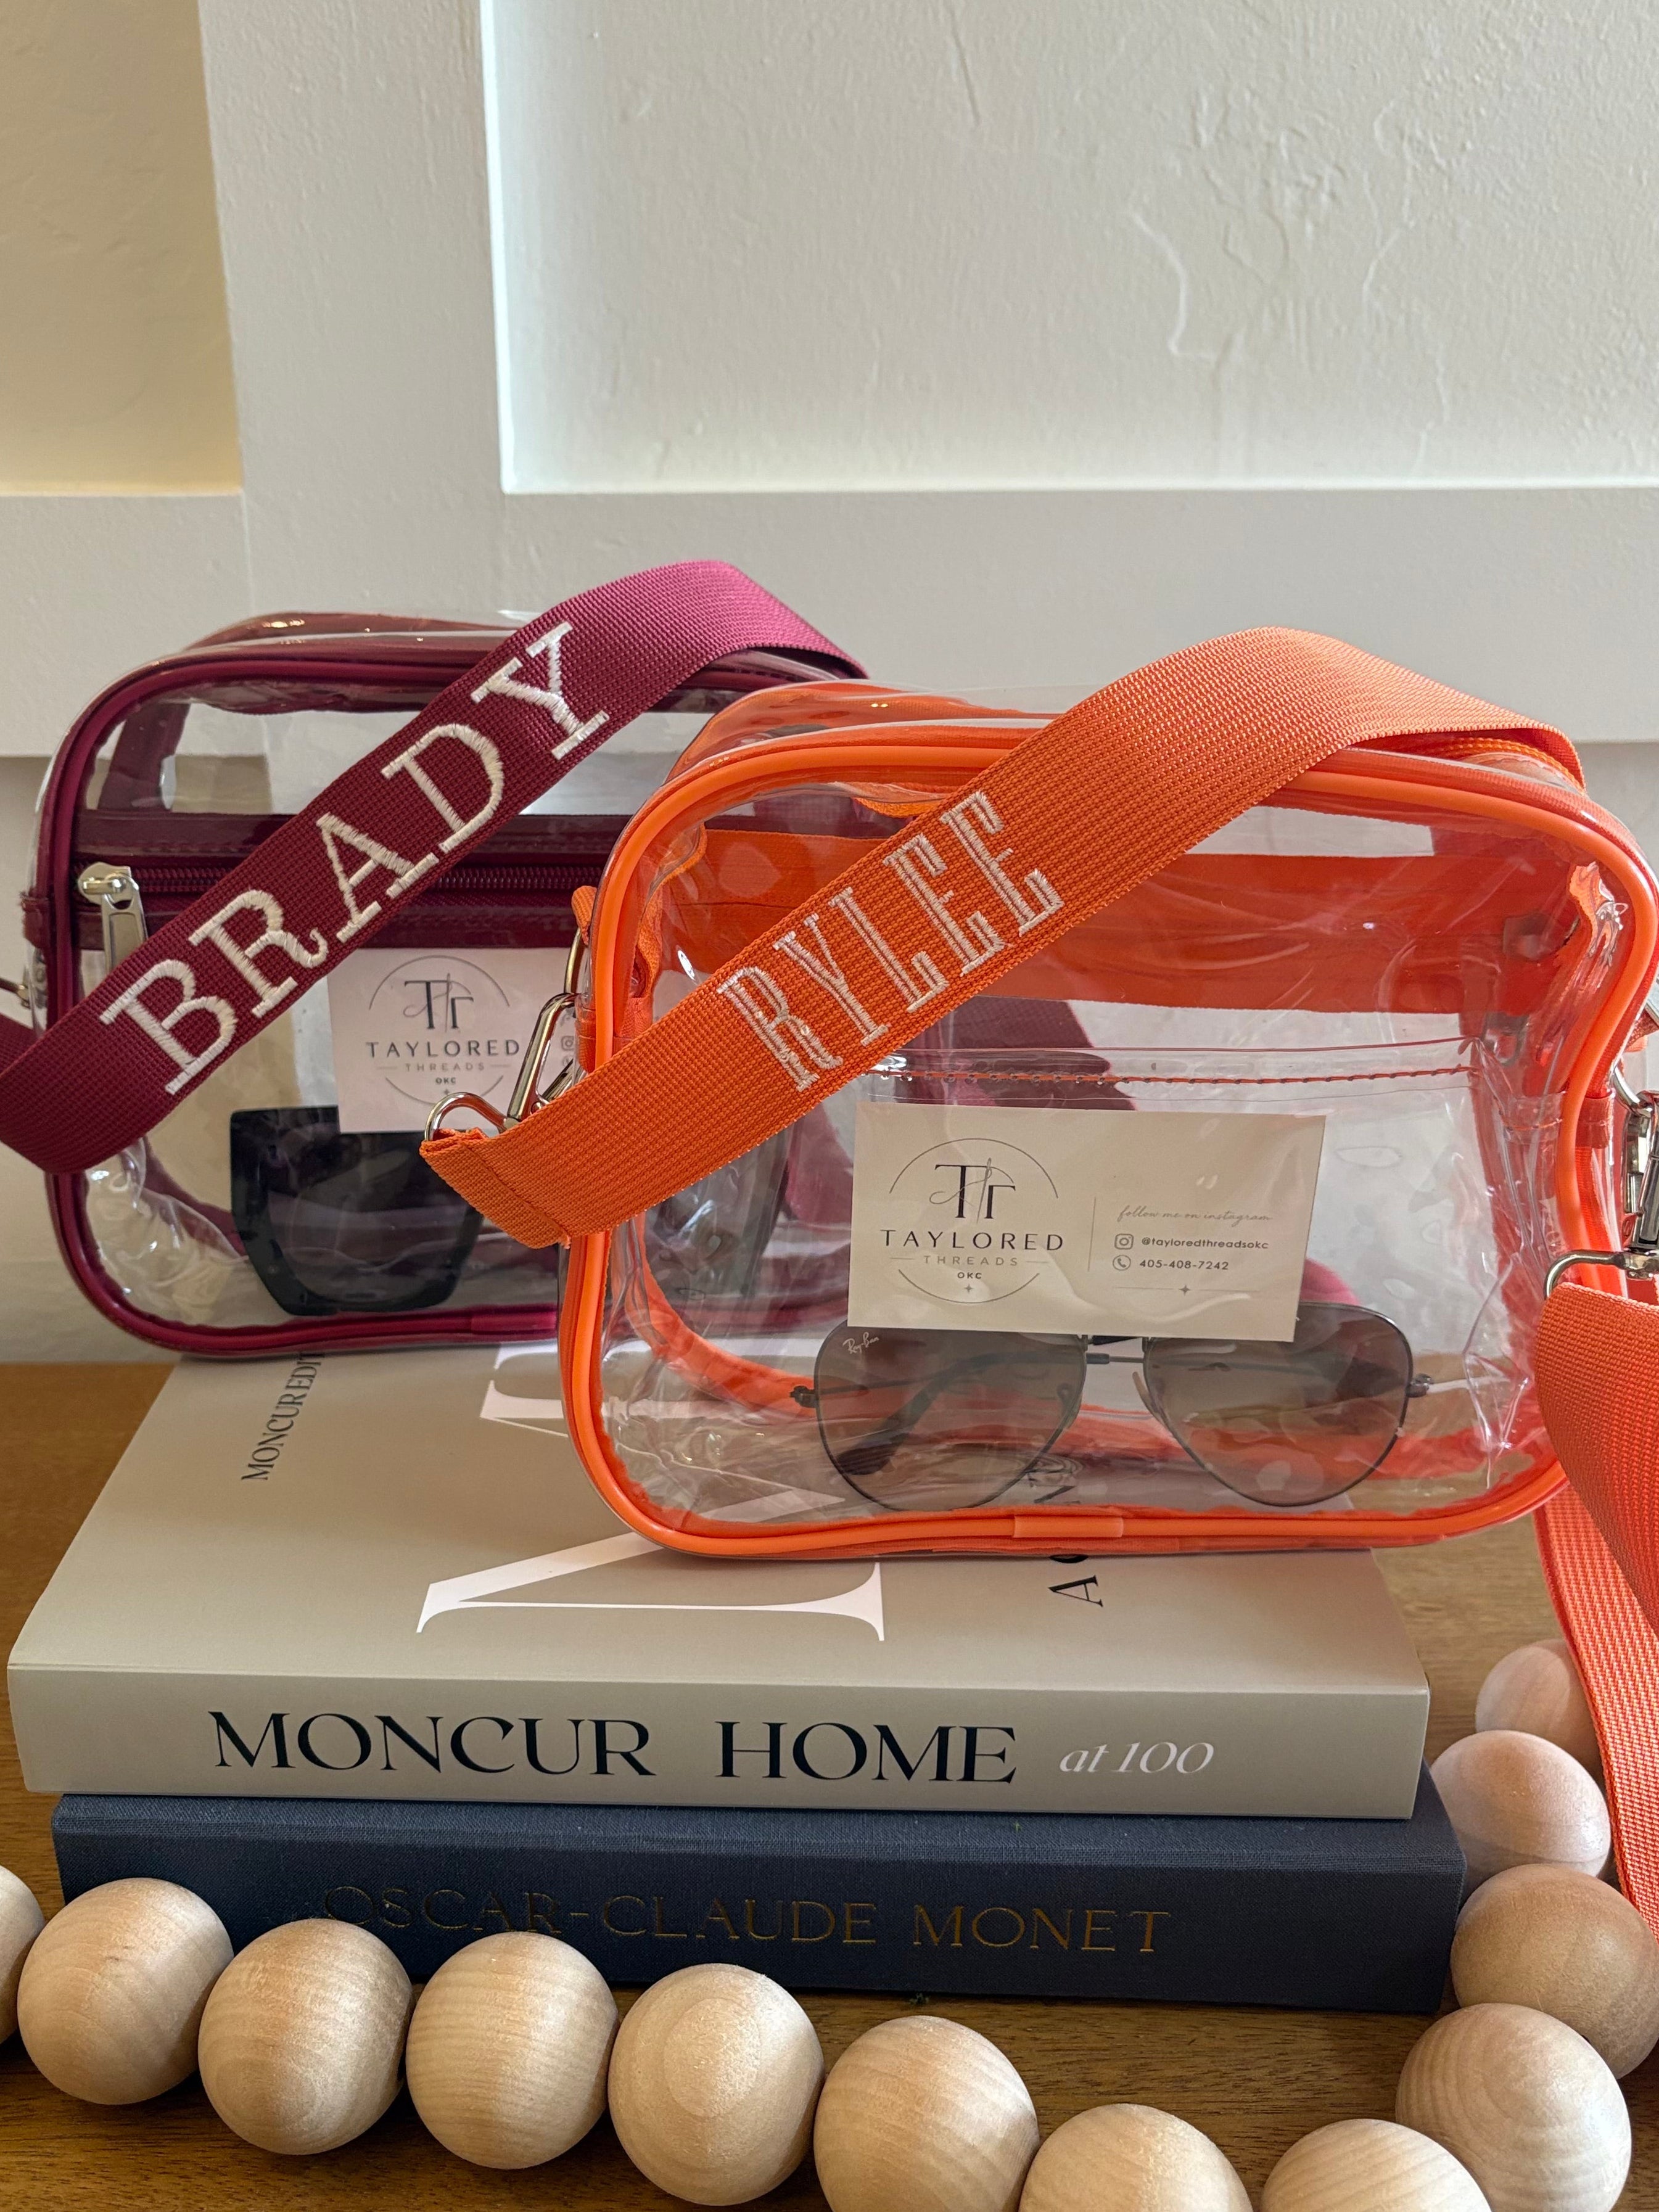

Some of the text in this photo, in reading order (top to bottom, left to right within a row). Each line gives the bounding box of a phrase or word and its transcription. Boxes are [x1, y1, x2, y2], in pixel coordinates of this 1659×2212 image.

[99, 621, 609, 1095] BRADY
[716, 790, 1064, 1092] RYLEE
[366, 1039, 520, 1058] TAYLORED
[405, 1062, 485, 1072] THREADS
[435, 1077, 456, 1085] OKC
[1117, 1204, 1159, 1222] follow
[1203, 1210, 1273, 1228] instagram
[879, 1229, 1064, 1251] TAYLORED
[1141, 1236, 1269, 1249] @tayloredthreadsokc
[923, 1255, 1019, 1267] THREADS
[1139, 1259, 1230, 1270] 405-408-7242
[957, 1271, 982, 1280] OKC
[241, 1393, 307, 1481] MONCUR
[207, 1711, 1215, 1784] MONCUR HOME at 100
[324, 1885, 1172, 1952] OSCAR-CLAUDE MONET
